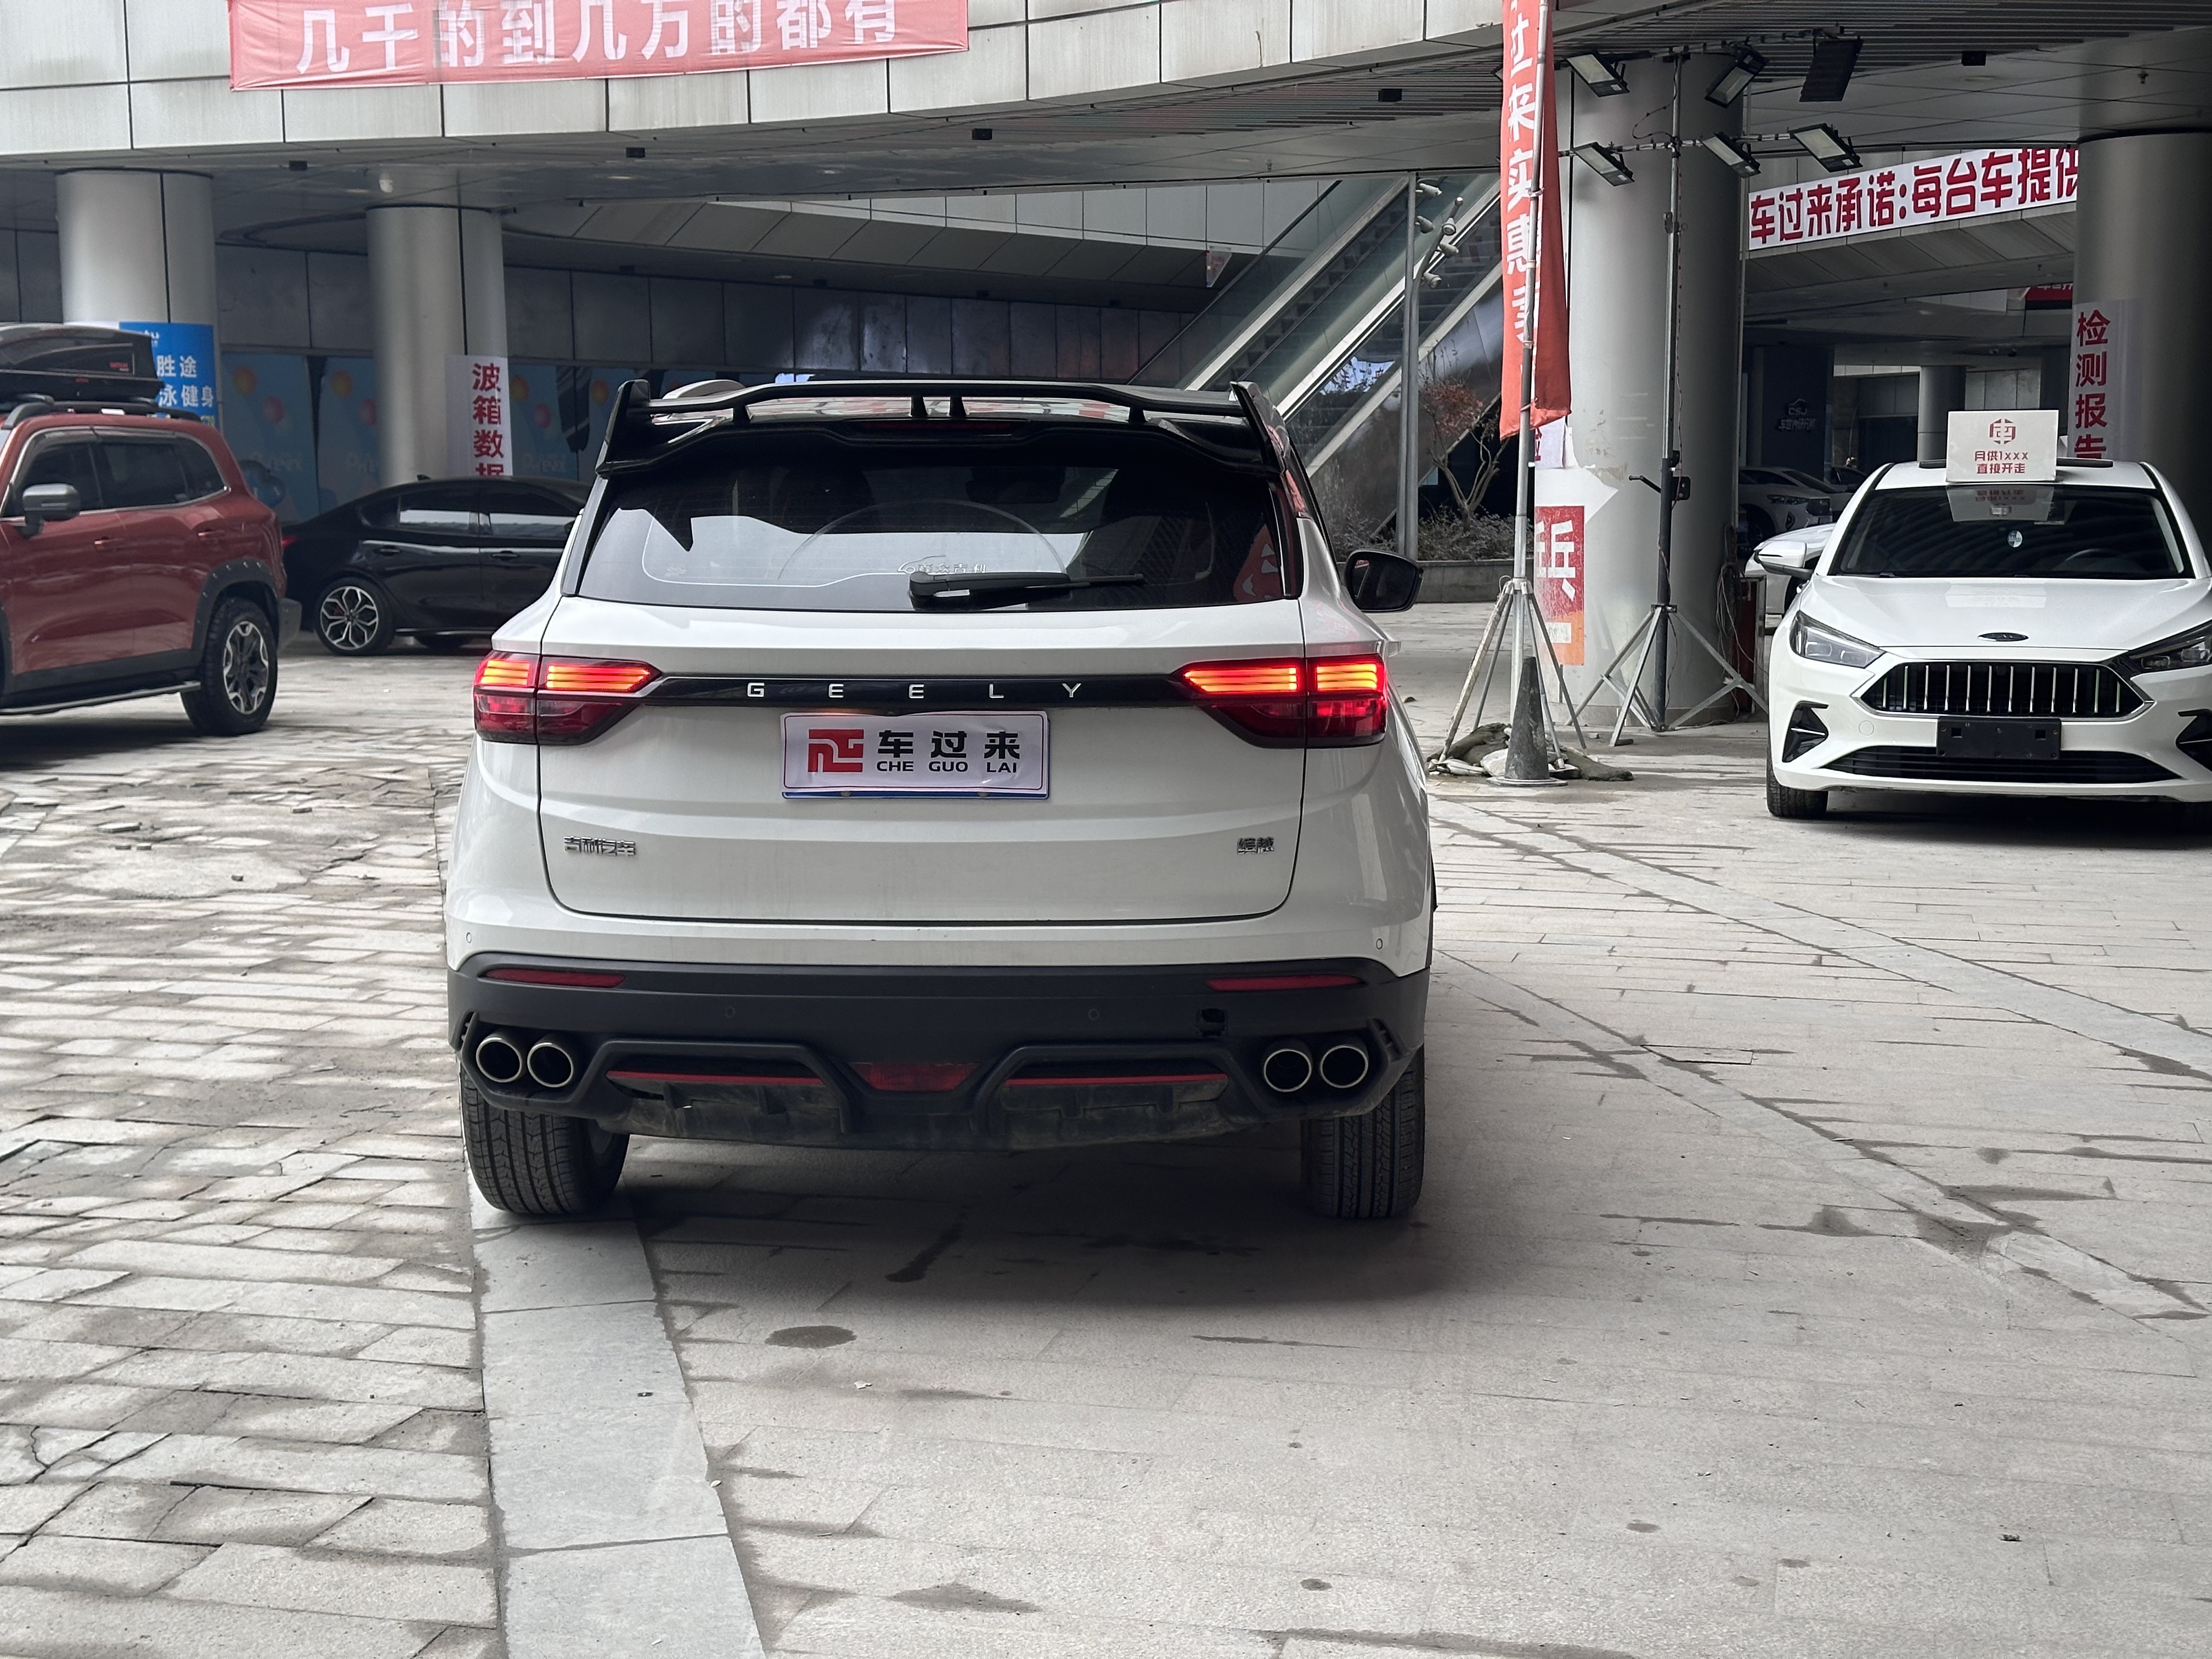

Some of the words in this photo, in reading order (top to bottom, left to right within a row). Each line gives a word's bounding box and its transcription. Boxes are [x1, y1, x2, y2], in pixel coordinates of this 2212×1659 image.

[2074, 309, 2111, 459] 检测报告
[747, 682, 1081, 699] GEELY
[877, 730, 1020, 759] 车过来
[877, 761, 914, 772] CHE
[928, 761, 968, 772] GUO
[986, 761, 1017, 774] LAI
